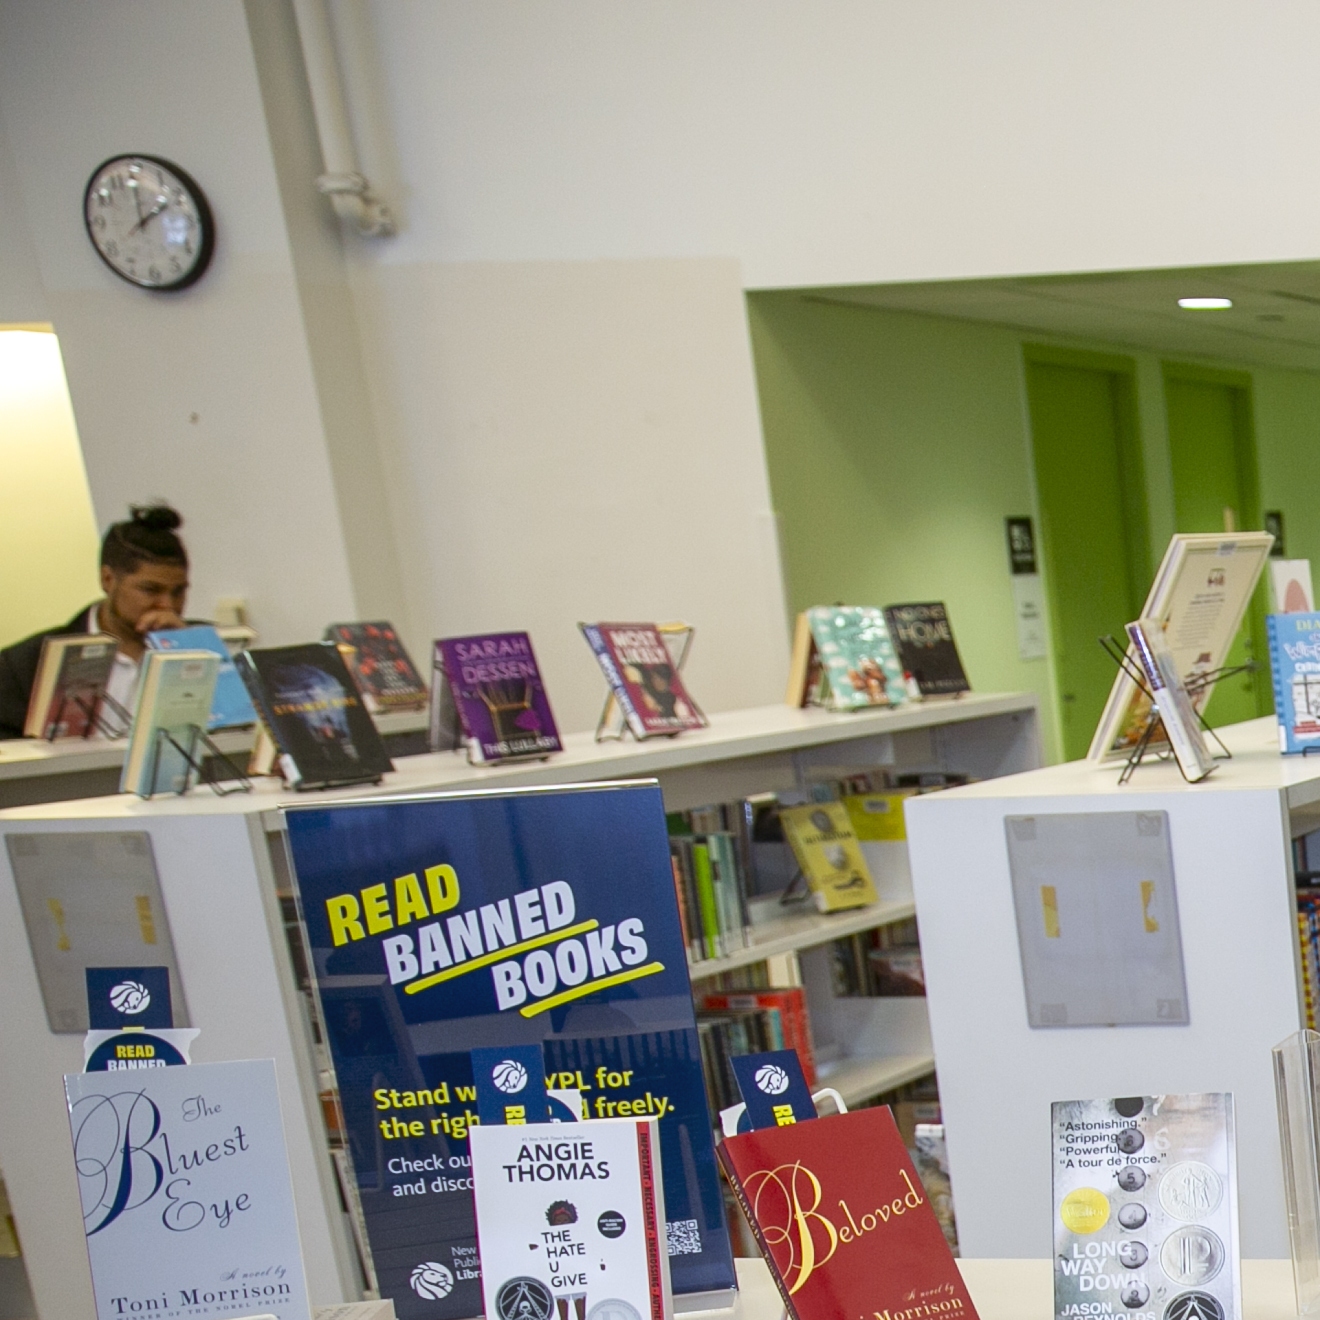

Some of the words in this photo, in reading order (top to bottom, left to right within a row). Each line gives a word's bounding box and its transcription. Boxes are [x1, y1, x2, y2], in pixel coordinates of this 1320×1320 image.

[454, 639, 529, 661] SARAH
[462, 660, 537, 684] DESSEN
[326, 863, 461, 947] READ
[381, 880, 576, 985] BANNED
[490, 917, 649, 1011] BOOKS
[116, 1045, 155, 1058] READ
[595, 1066, 634, 1088] for
[374, 1082, 451, 1110] Stand
[595, 1092, 675, 1119] freely.
[182, 1095, 222, 1122] The
[380, 1118, 425, 1140] the
[74, 1088, 250, 1237] Bluest
[517, 1142, 594, 1162] ANGIE
[388, 1153, 443, 1175] Check
[502, 1161, 610, 1183] THOMAS
[392, 1180, 427, 1197] and
[161, 1178, 252, 1231] Eye
[541, 1230, 572, 1244] THE
[742, 1160, 924, 1296] Beloved
[547, 1243, 586, 1259] HATE
[1073, 1240, 1133, 1260] LONG
[550, 1262, 559, 1274] U
[1061, 1259, 1107, 1276] WAY
[551, 1273, 588, 1288] GIVE
[1079, 1274, 1148, 1292] DOWN
[111, 1295, 170, 1315] Toni
[180, 1280, 293, 1308] Morrison
[1061, 1302, 1113, 1316] JASON
